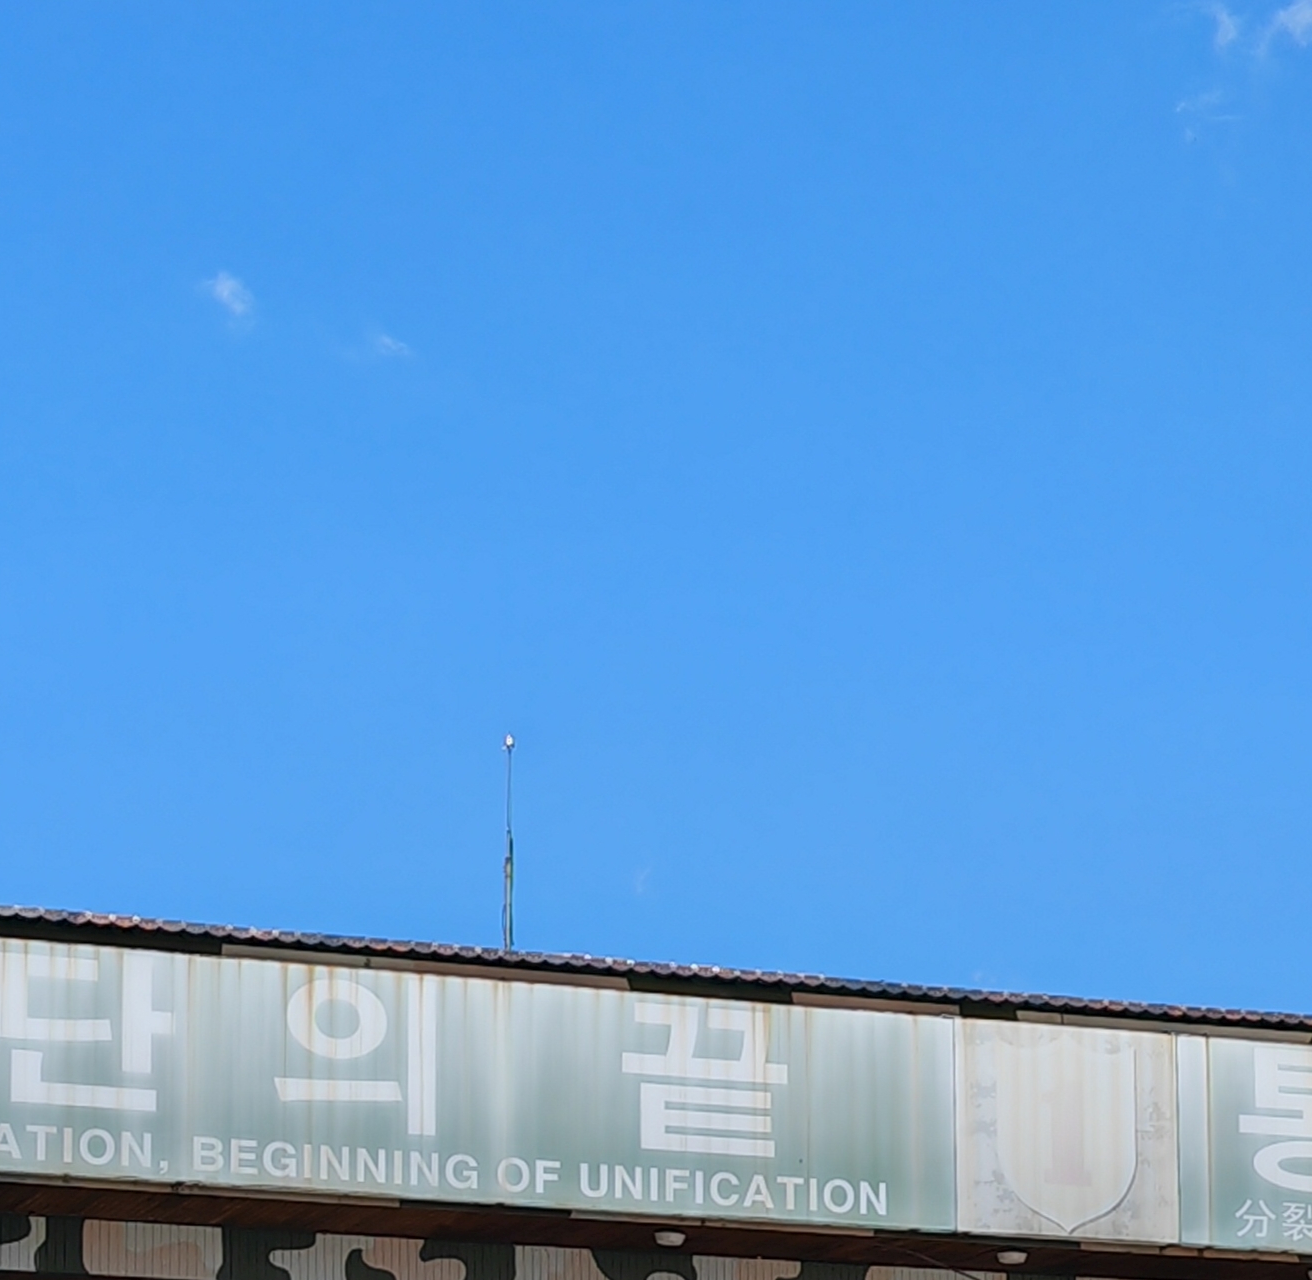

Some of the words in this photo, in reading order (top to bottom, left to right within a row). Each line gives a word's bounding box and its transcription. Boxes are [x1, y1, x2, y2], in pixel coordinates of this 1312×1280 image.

[622, 1001, 788, 1158] 끝
[192, 1136, 480, 1190] BEGINNING
[497, 1158, 562, 1194] OF
[580, 1163, 887, 1216] UNIFICATION
